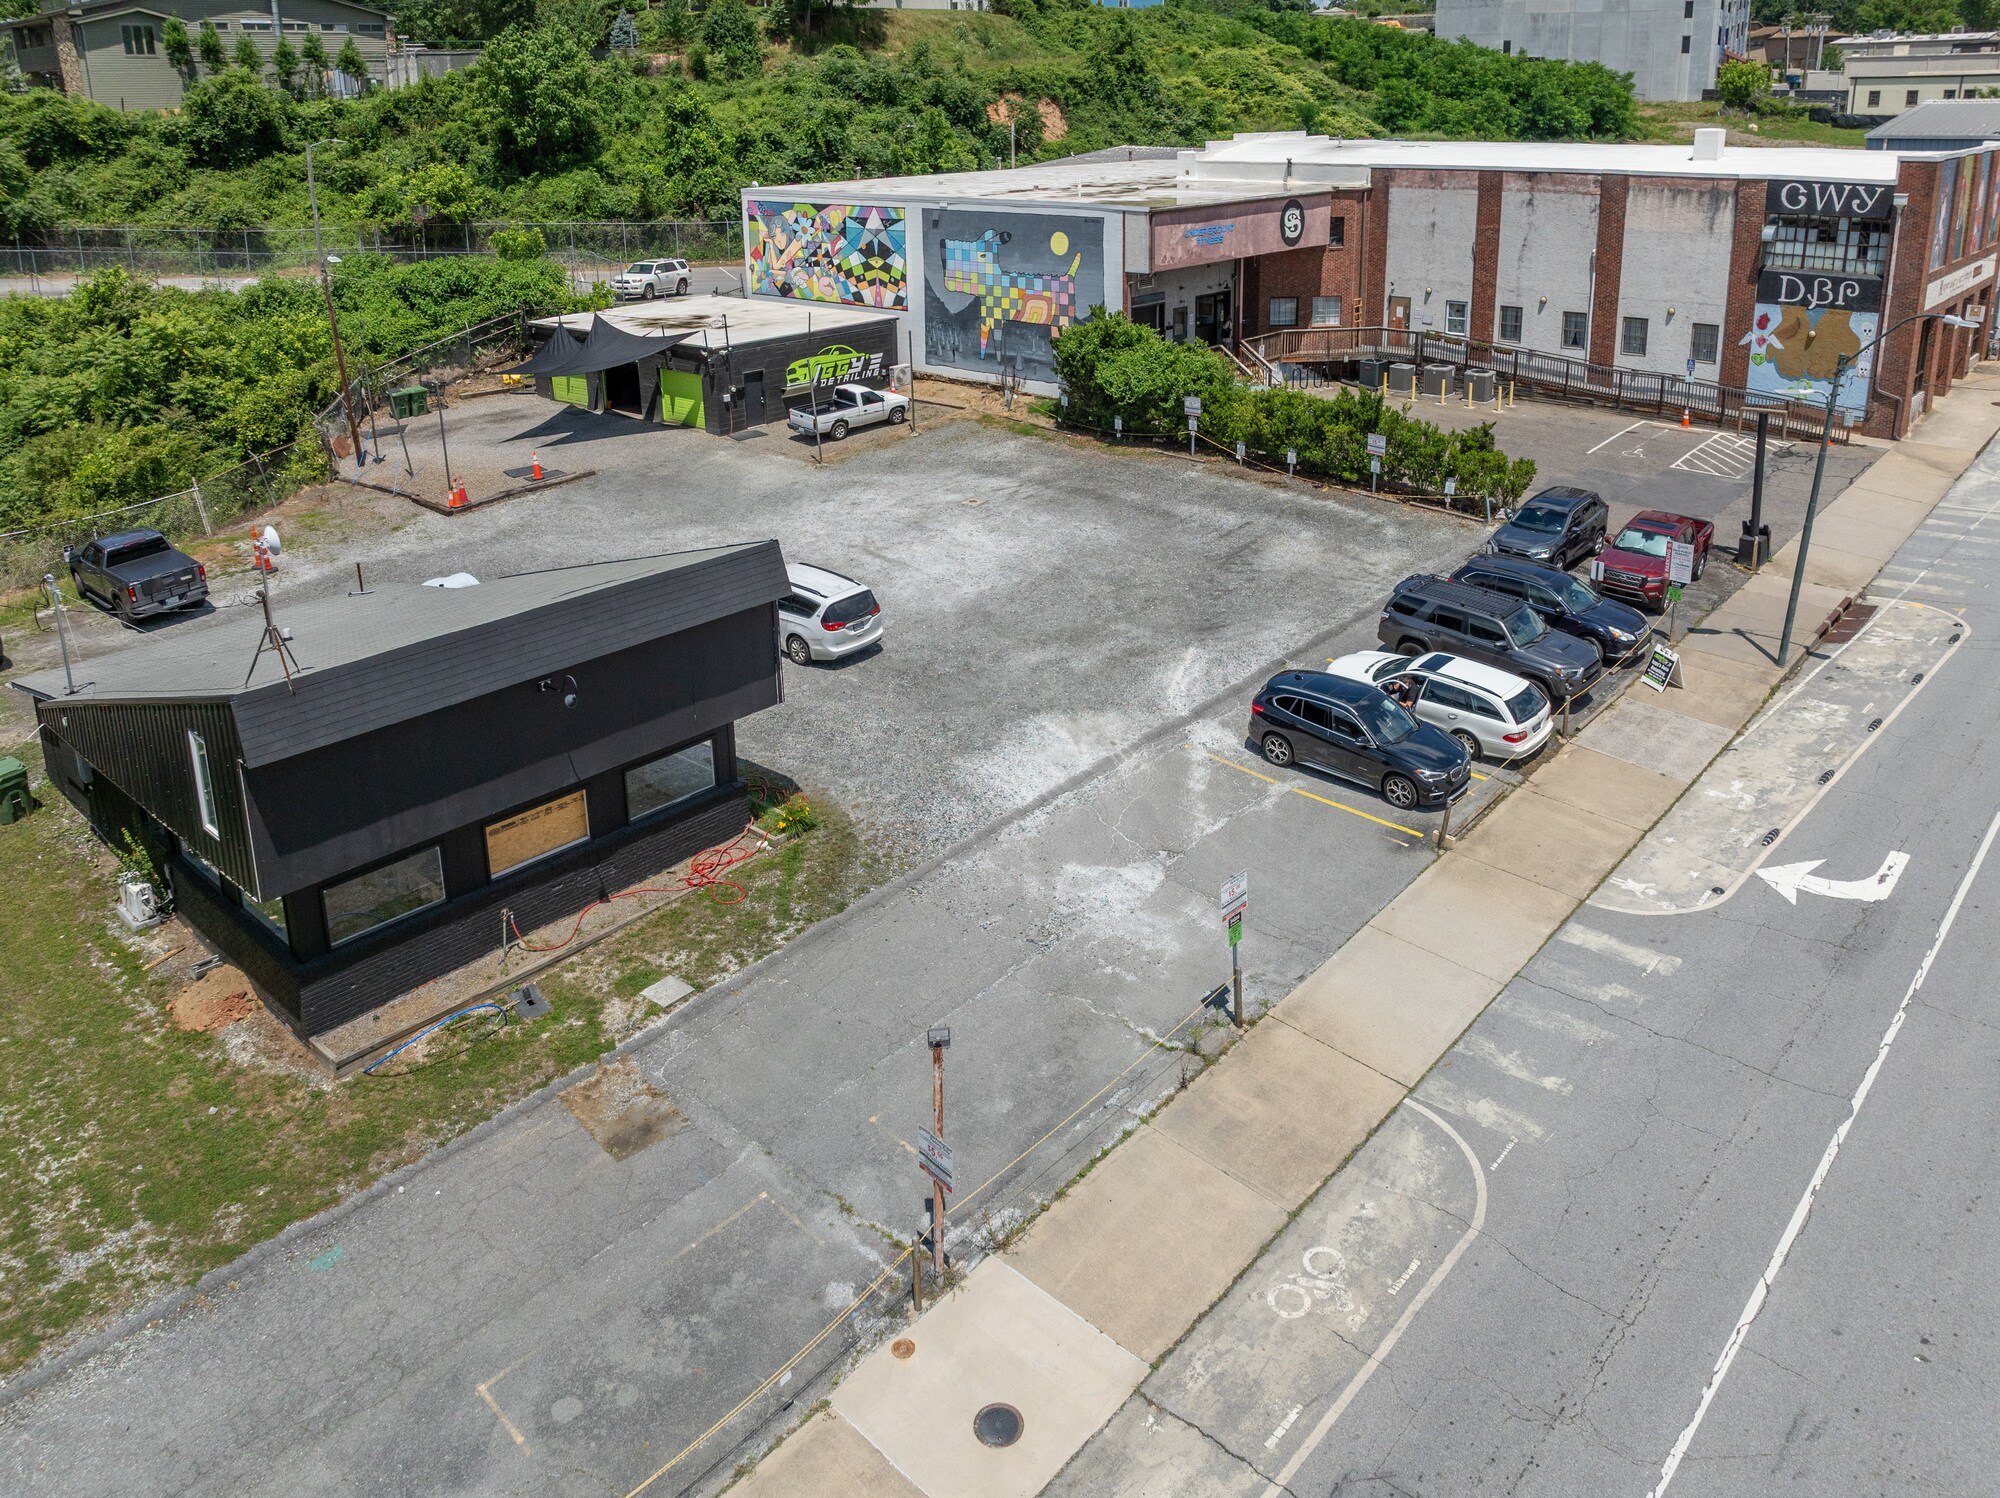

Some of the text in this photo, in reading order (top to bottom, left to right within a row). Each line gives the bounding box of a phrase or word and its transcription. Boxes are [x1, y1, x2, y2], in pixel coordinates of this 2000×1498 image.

[1184, 224, 1235, 238] UNDERGROUND
[1196, 236, 1224, 246] FITNESS
[820, 369, 880, 387] DETAILING
